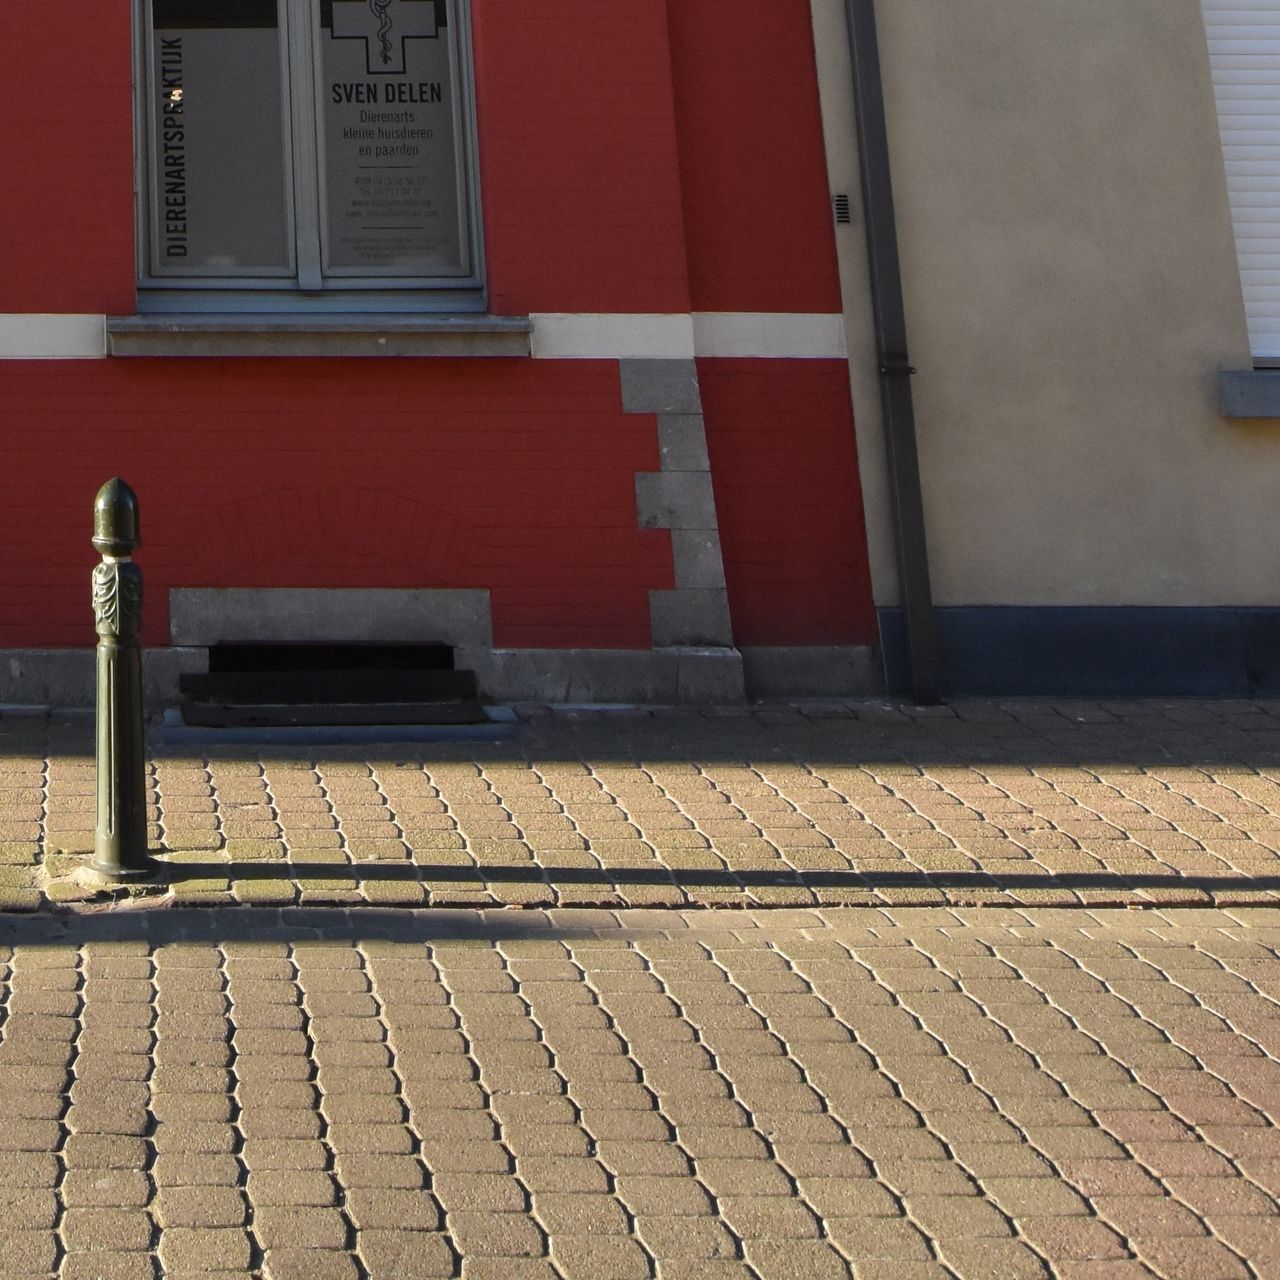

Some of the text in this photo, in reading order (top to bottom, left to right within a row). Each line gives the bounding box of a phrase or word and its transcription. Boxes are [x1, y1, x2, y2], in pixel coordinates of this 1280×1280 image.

[332, 82, 442, 104] SVEN DELEN
[360, 110, 416, 123] Dierenarts
[343, 126, 433, 139] kleine huisdieren
[359, 144, 419, 158] en paarden
